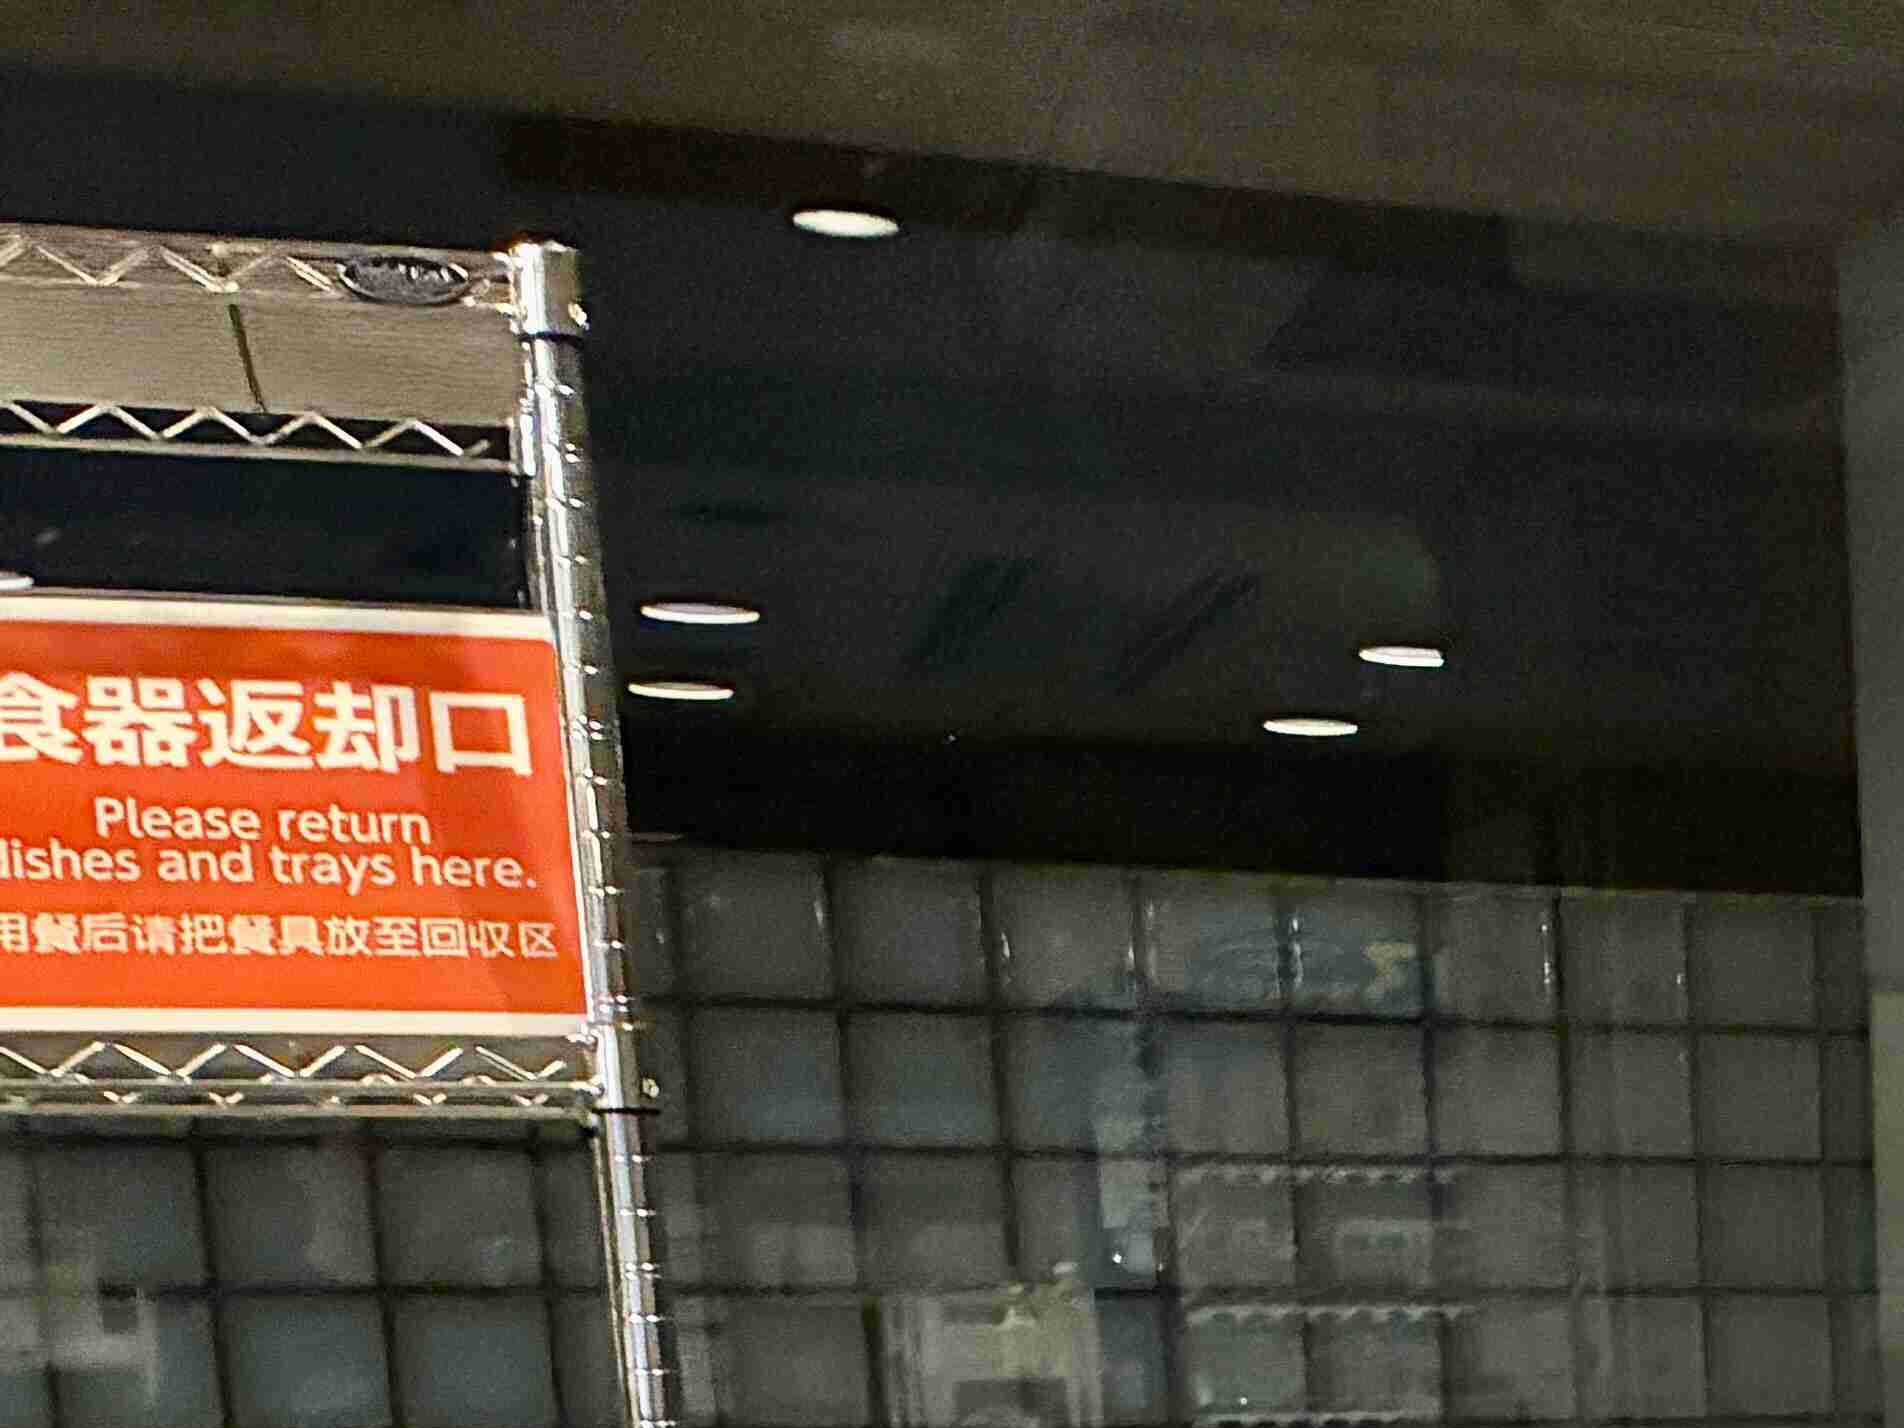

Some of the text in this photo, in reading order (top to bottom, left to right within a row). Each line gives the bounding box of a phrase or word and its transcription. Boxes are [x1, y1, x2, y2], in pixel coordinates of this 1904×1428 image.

[0, 671, 533, 775] 食器返却口
[94, 797, 431, 845] Please return
[157, 842, 253, 883] and
[270, 849, 396, 896] trays
[411, 851, 537, 889] here.
[0, 913, 557, 960] 用餐后请把餐具放至回收区
